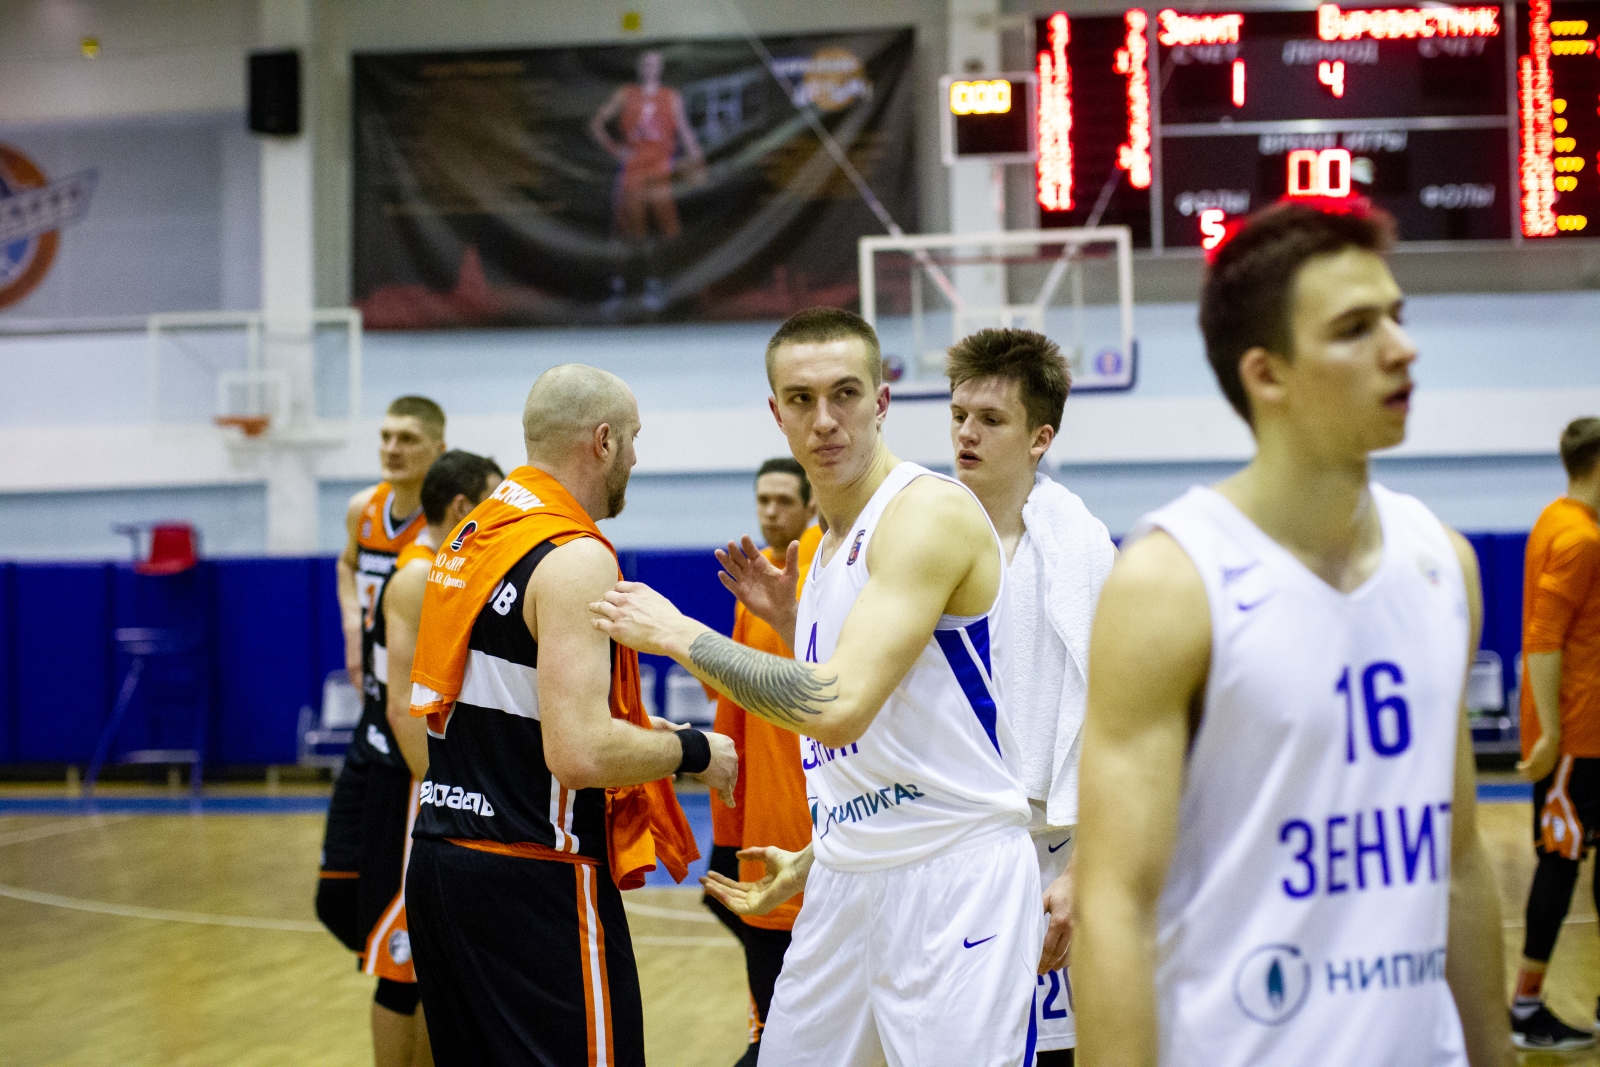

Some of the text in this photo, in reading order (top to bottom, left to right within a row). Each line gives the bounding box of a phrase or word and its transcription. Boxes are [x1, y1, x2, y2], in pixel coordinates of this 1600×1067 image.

[1232, 57, 1246, 108] 1
[1317, 59, 1345, 98] 4
[1200, 208, 1226, 250] 5
[1335, 661, 1412, 764] 16
